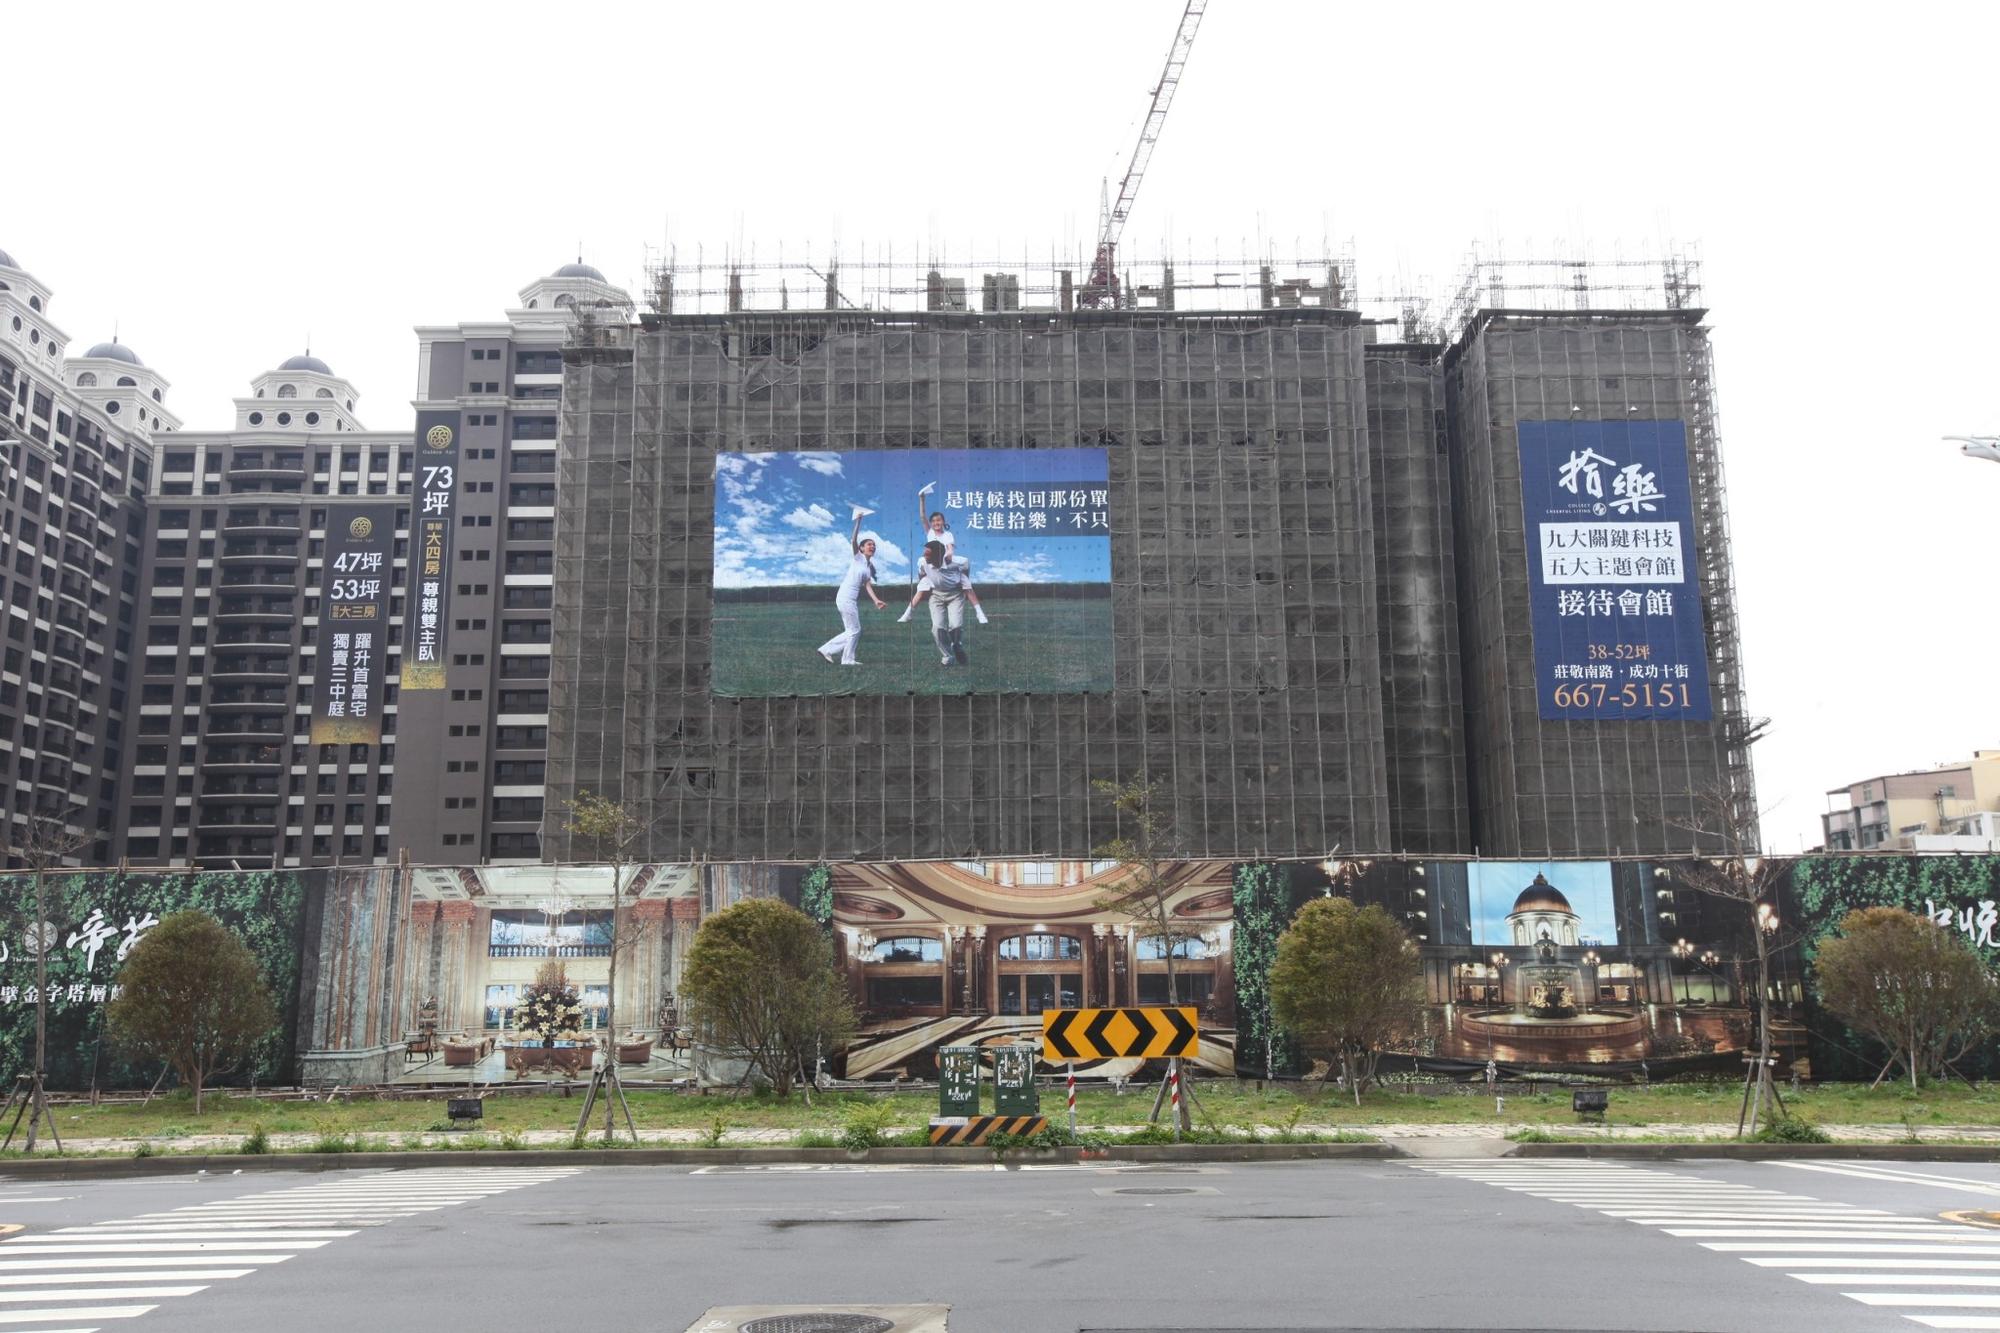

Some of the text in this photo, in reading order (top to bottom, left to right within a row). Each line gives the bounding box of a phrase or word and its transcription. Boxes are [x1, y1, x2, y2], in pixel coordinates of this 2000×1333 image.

[422, 465, 453, 489] 73
[1558, 447, 1667, 514] 拾樂
[422, 491, 449, 515] 坪
[945, 489, 1108, 509] 是時候找回那份單
[966, 511, 1109, 530] 走進拾樂，不只
[1547, 528, 1674, 549] 九大關鍵科技
[333, 552, 383, 573] 47坪
[424, 531, 442, 575] 大四房
[1548, 556, 1677, 577] 五大主題會館
[330, 579, 381, 600] 53坪
[339, 605, 376, 618] 大三房
[1557, 588, 1674, 617] 接待會館
[418, 581, 440, 662] 尊親雙主臥
[1588, 644, 1650, 660] 38-52坪
[328, 632, 350, 717] 獨賣三中庭
[350, 632, 372, 717] 躍升首富宅
[1554, 683, 1691, 708] 667-5151
